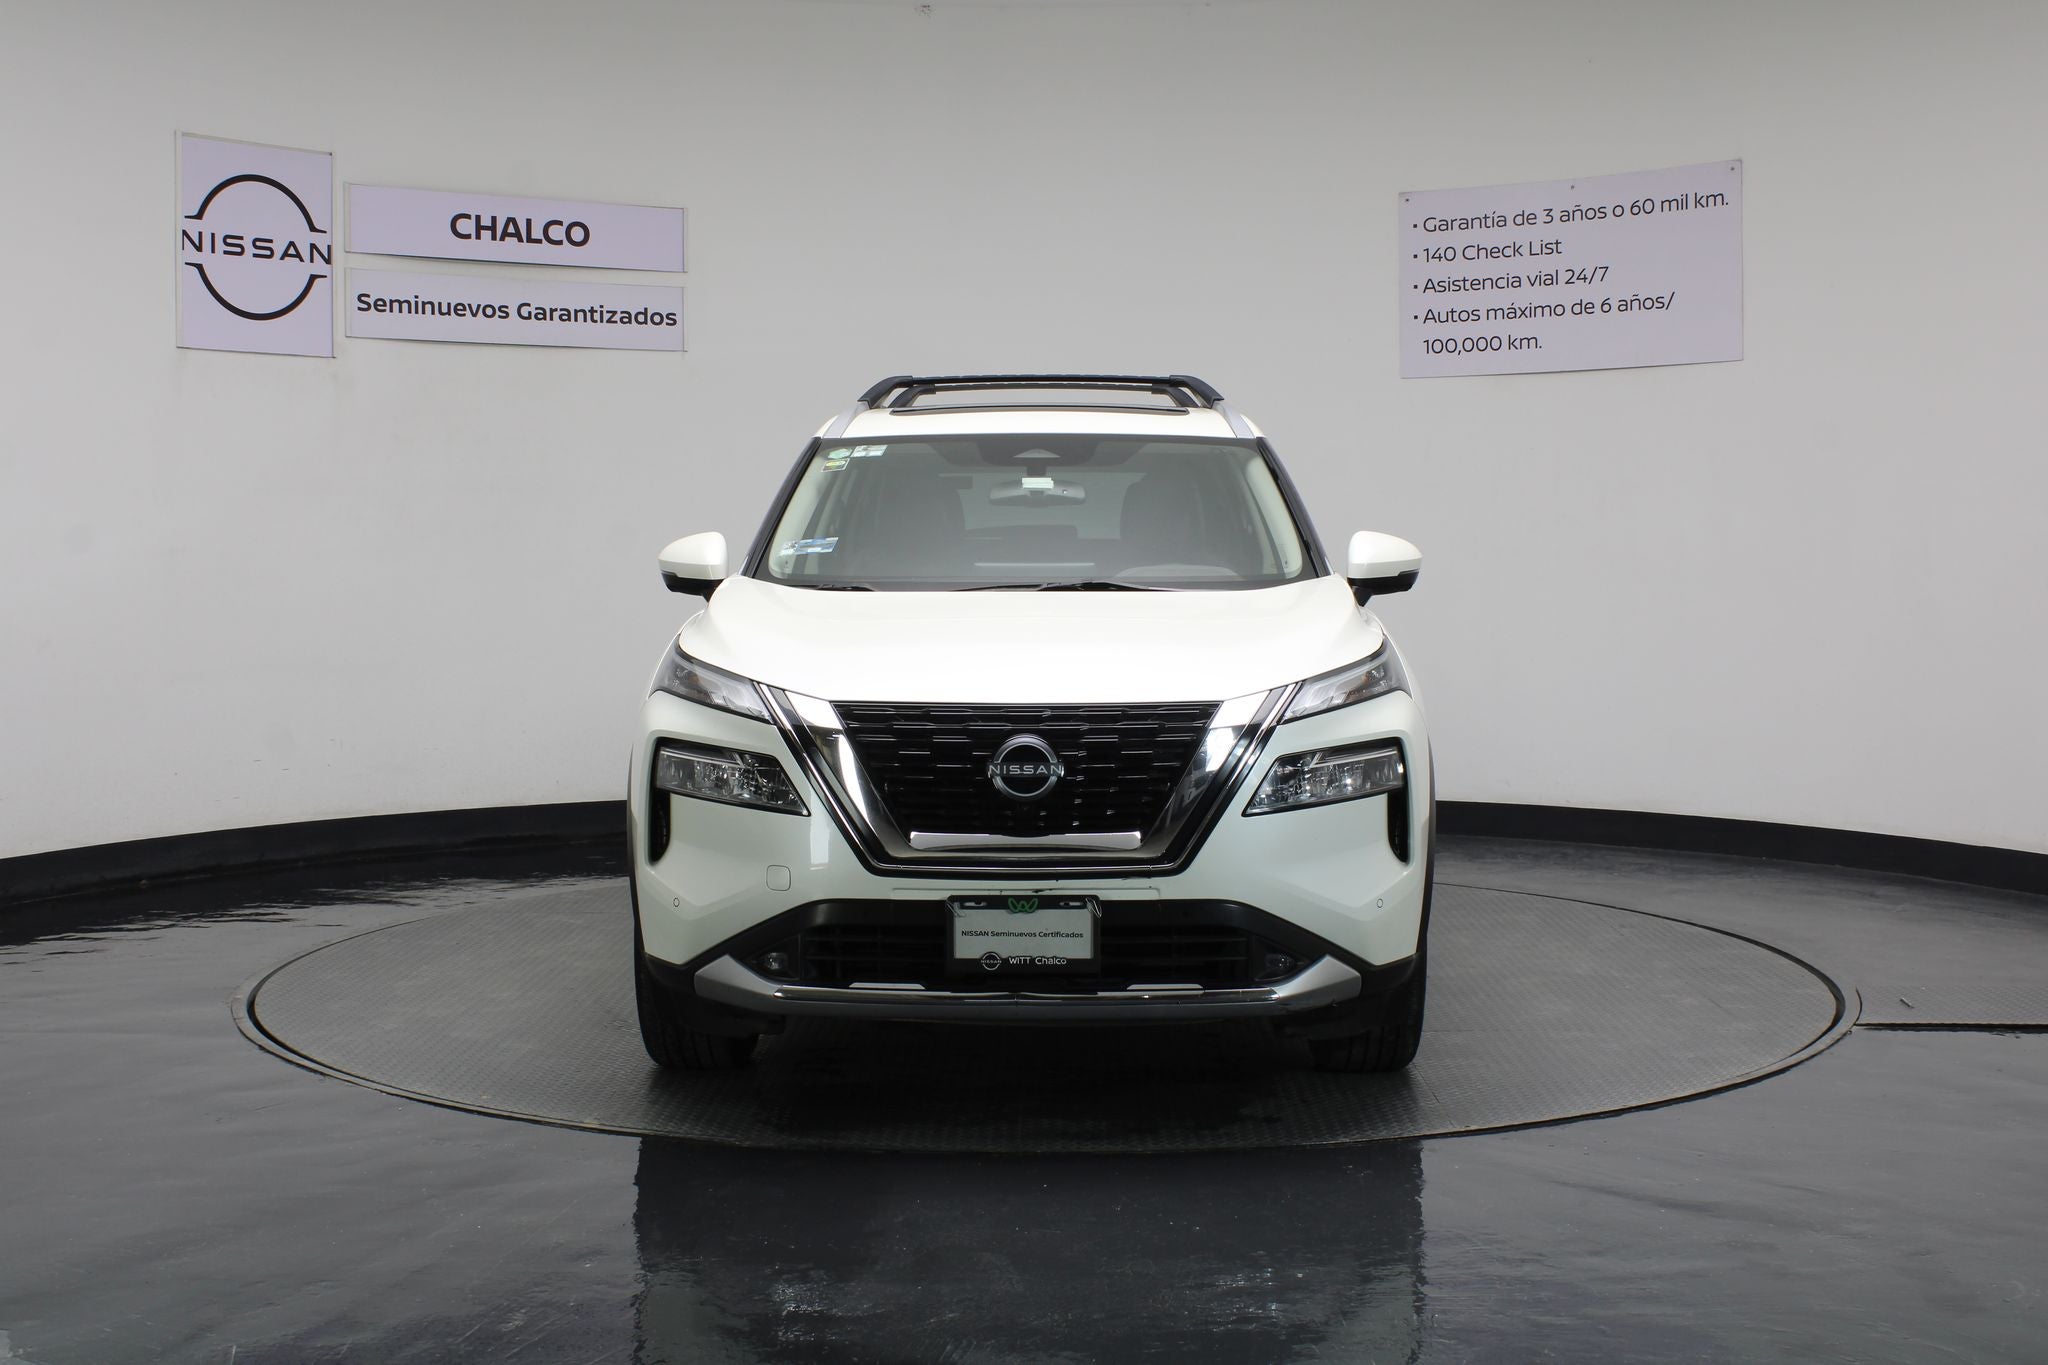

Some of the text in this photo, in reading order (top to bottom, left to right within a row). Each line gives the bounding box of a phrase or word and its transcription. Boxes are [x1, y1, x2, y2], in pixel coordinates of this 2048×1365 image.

[1423, 192, 1729, 233] Garantía de 3 años o 60 mil km.
[450, 213, 591, 247] CHALCO
[181, 229, 332, 265] NISSAN
[1423, 239, 1563, 263] 140 Check List
[1423, 266, 1609, 294] Asistencia vial 24/7
[356, 293, 678, 327] Seminuevos Garantizados
[1423, 291, 1676, 324] Autos máximo de 6 años/
[1423, 333, 1542, 356] 100,000 km.
[988, 765, 1062, 775] NISSAN
[991, 930, 1037, 938] Seminuevos
[1038, 930, 1084, 938] Certificados
[1009, 956, 1067, 965] WITT Chalco
